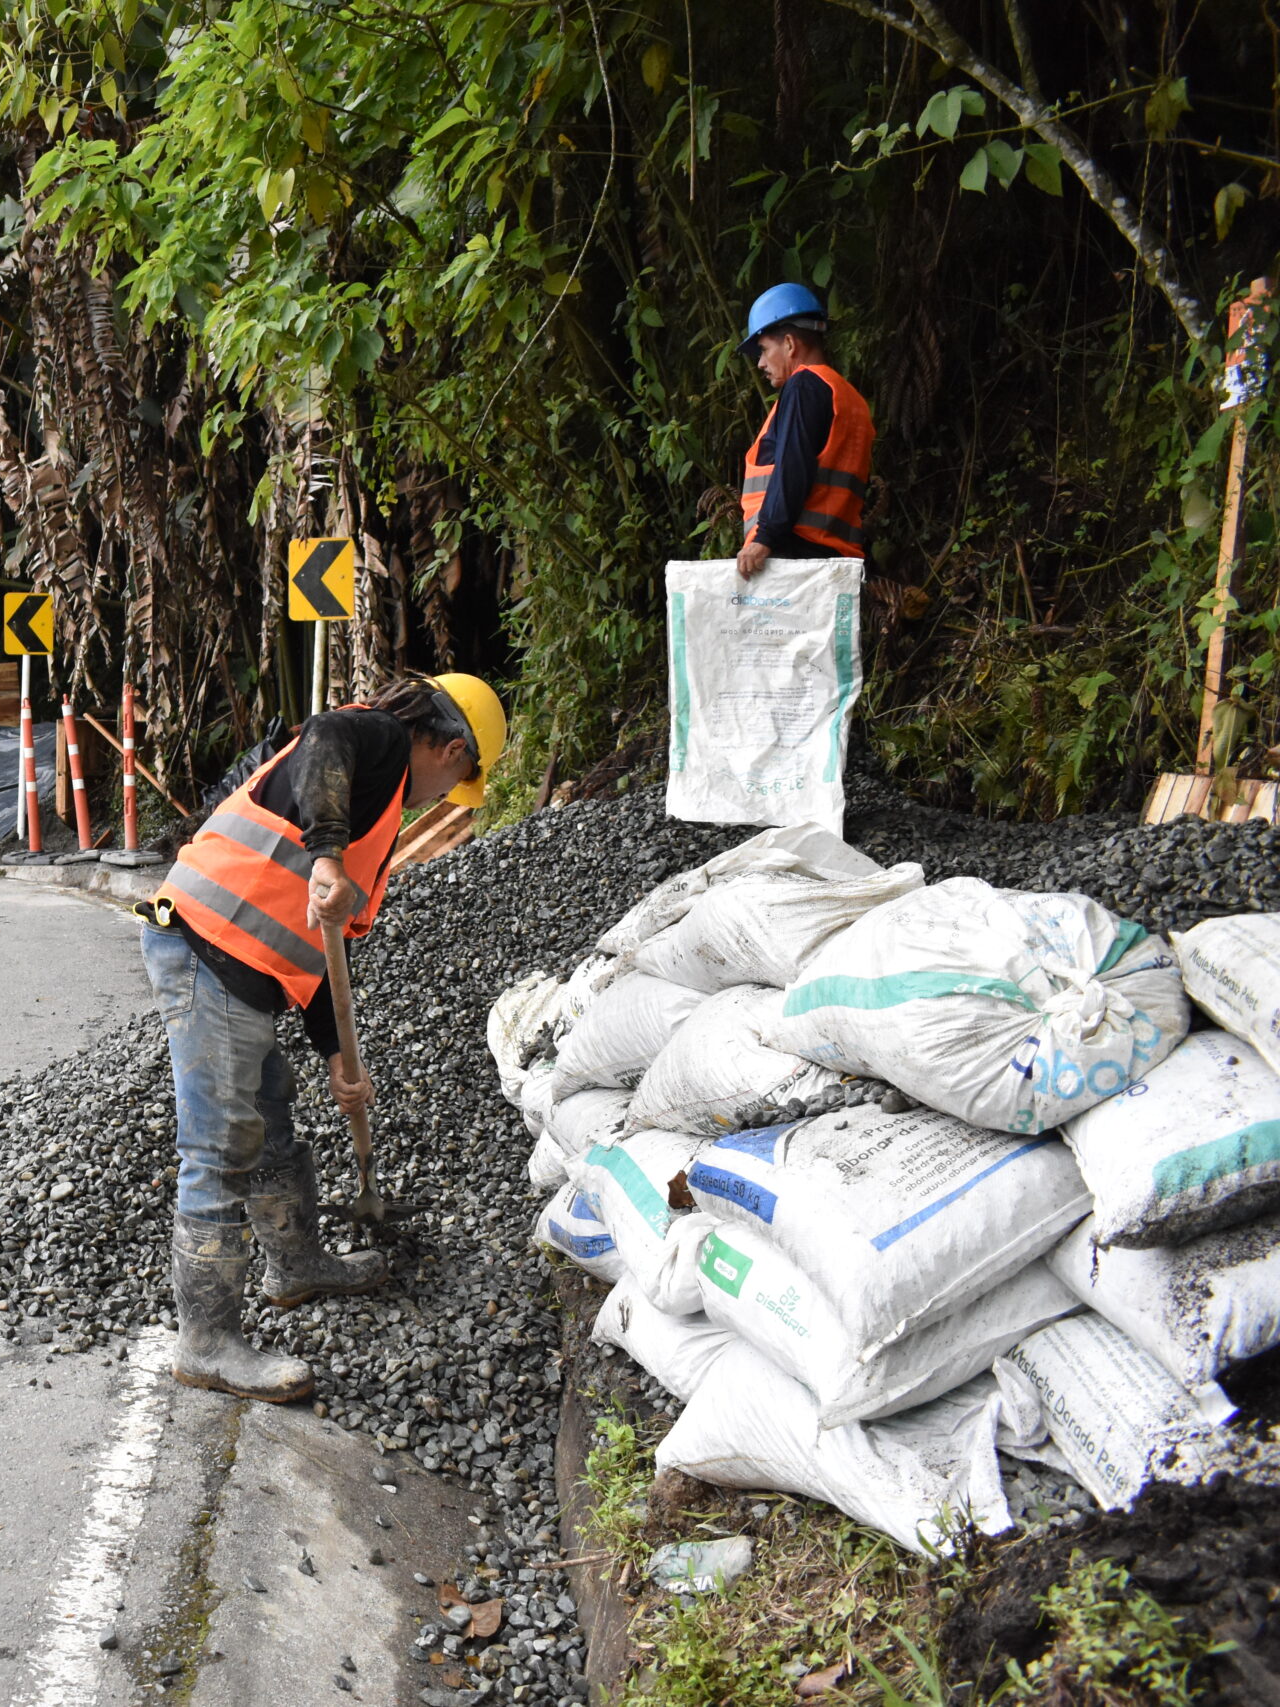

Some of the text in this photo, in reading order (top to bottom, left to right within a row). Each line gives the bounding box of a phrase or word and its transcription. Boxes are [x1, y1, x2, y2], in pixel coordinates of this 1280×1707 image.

[836, 1136, 894, 1173] Abonar
[899, 1124, 920, 1136] de
[698, 1170, 731, 1193] Especial
[747, 1186, 760, 1211] kg
[888, 1175, 908, 1188] San
[908, 1156, 936, 1175] Pedro
[1006, 1344, 1055, 1401] Masleche
[1054, 1394, 1096, 1454] Dorado
